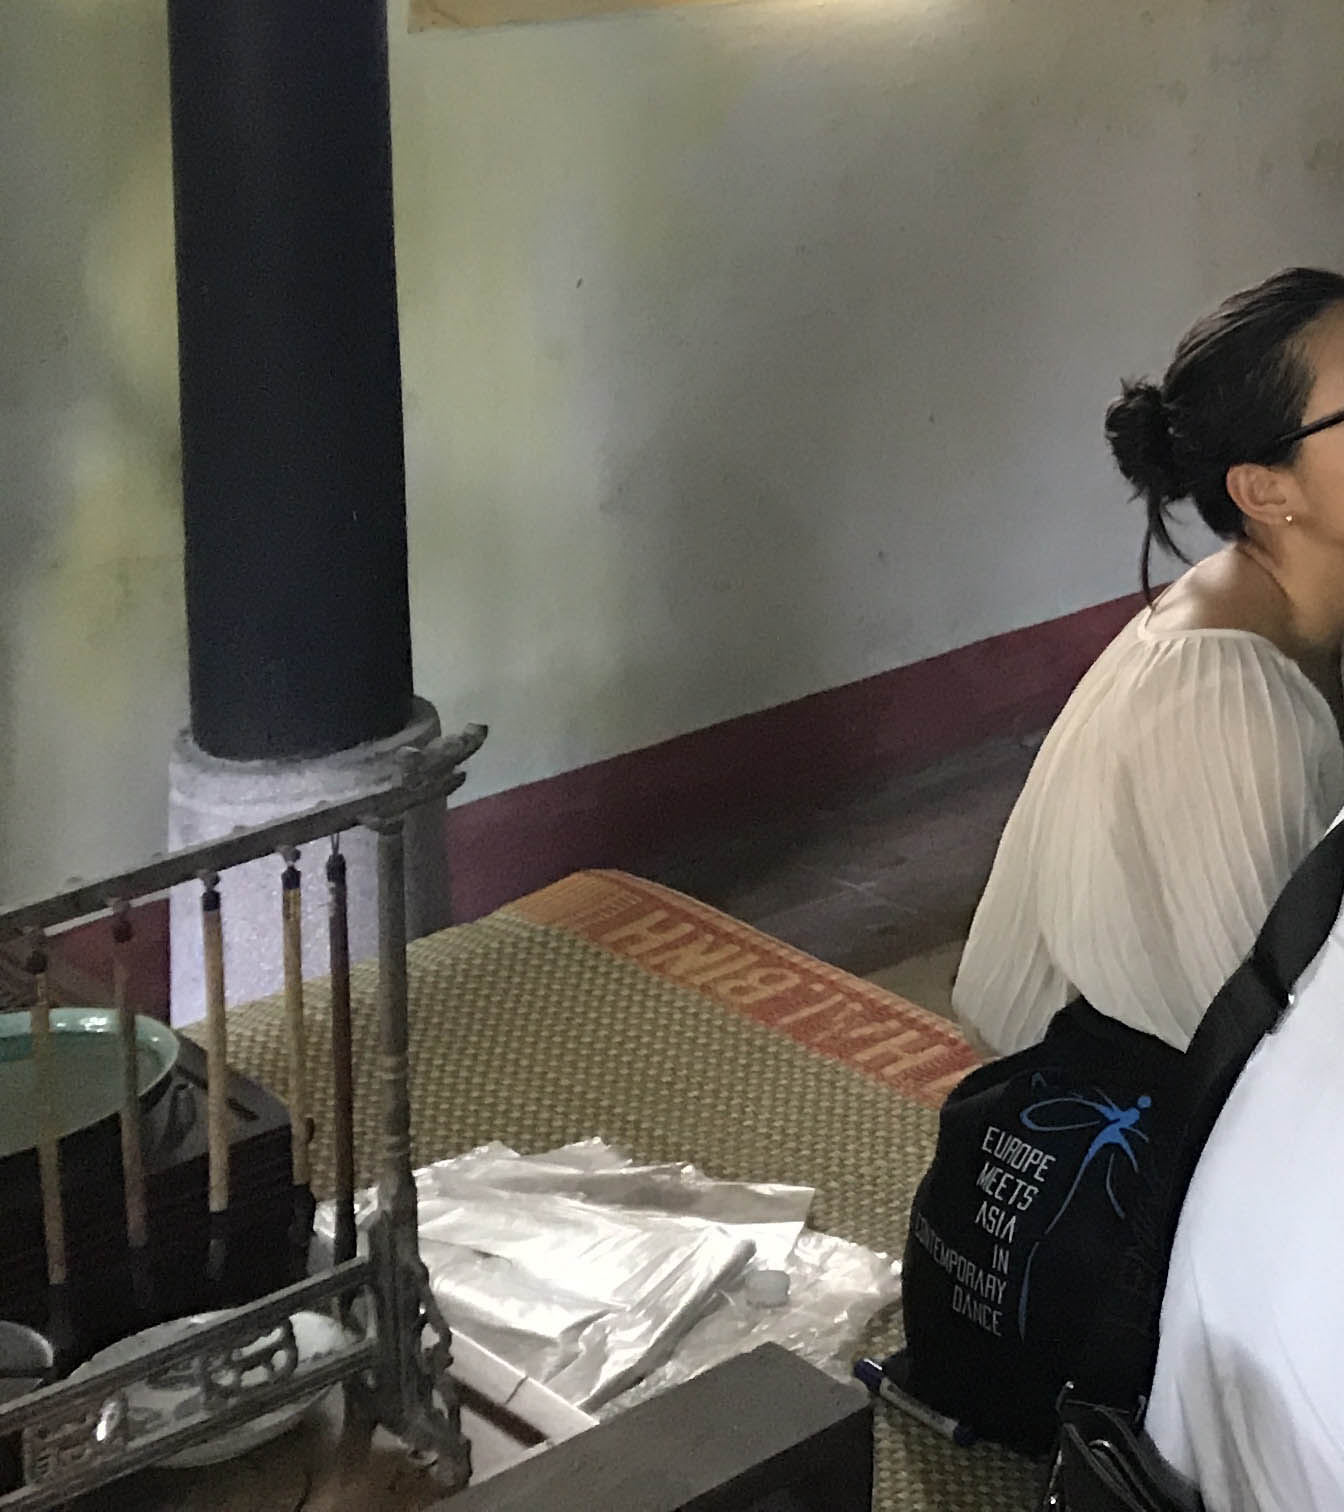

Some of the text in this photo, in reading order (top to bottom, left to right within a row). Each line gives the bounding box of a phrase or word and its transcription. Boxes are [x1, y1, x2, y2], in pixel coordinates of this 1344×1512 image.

[981, 1125, 1057, 1183] EUROPE
[975, 1160, 1040, 1212] MEETS
[974, 1200, 1018, 1244] ASIA
[914, 1212, 1007, 1305] CONTEMPORARY
[992, 1243, 1010, 1276] IN
[952, 1284, 1003, 1337] DANCE
